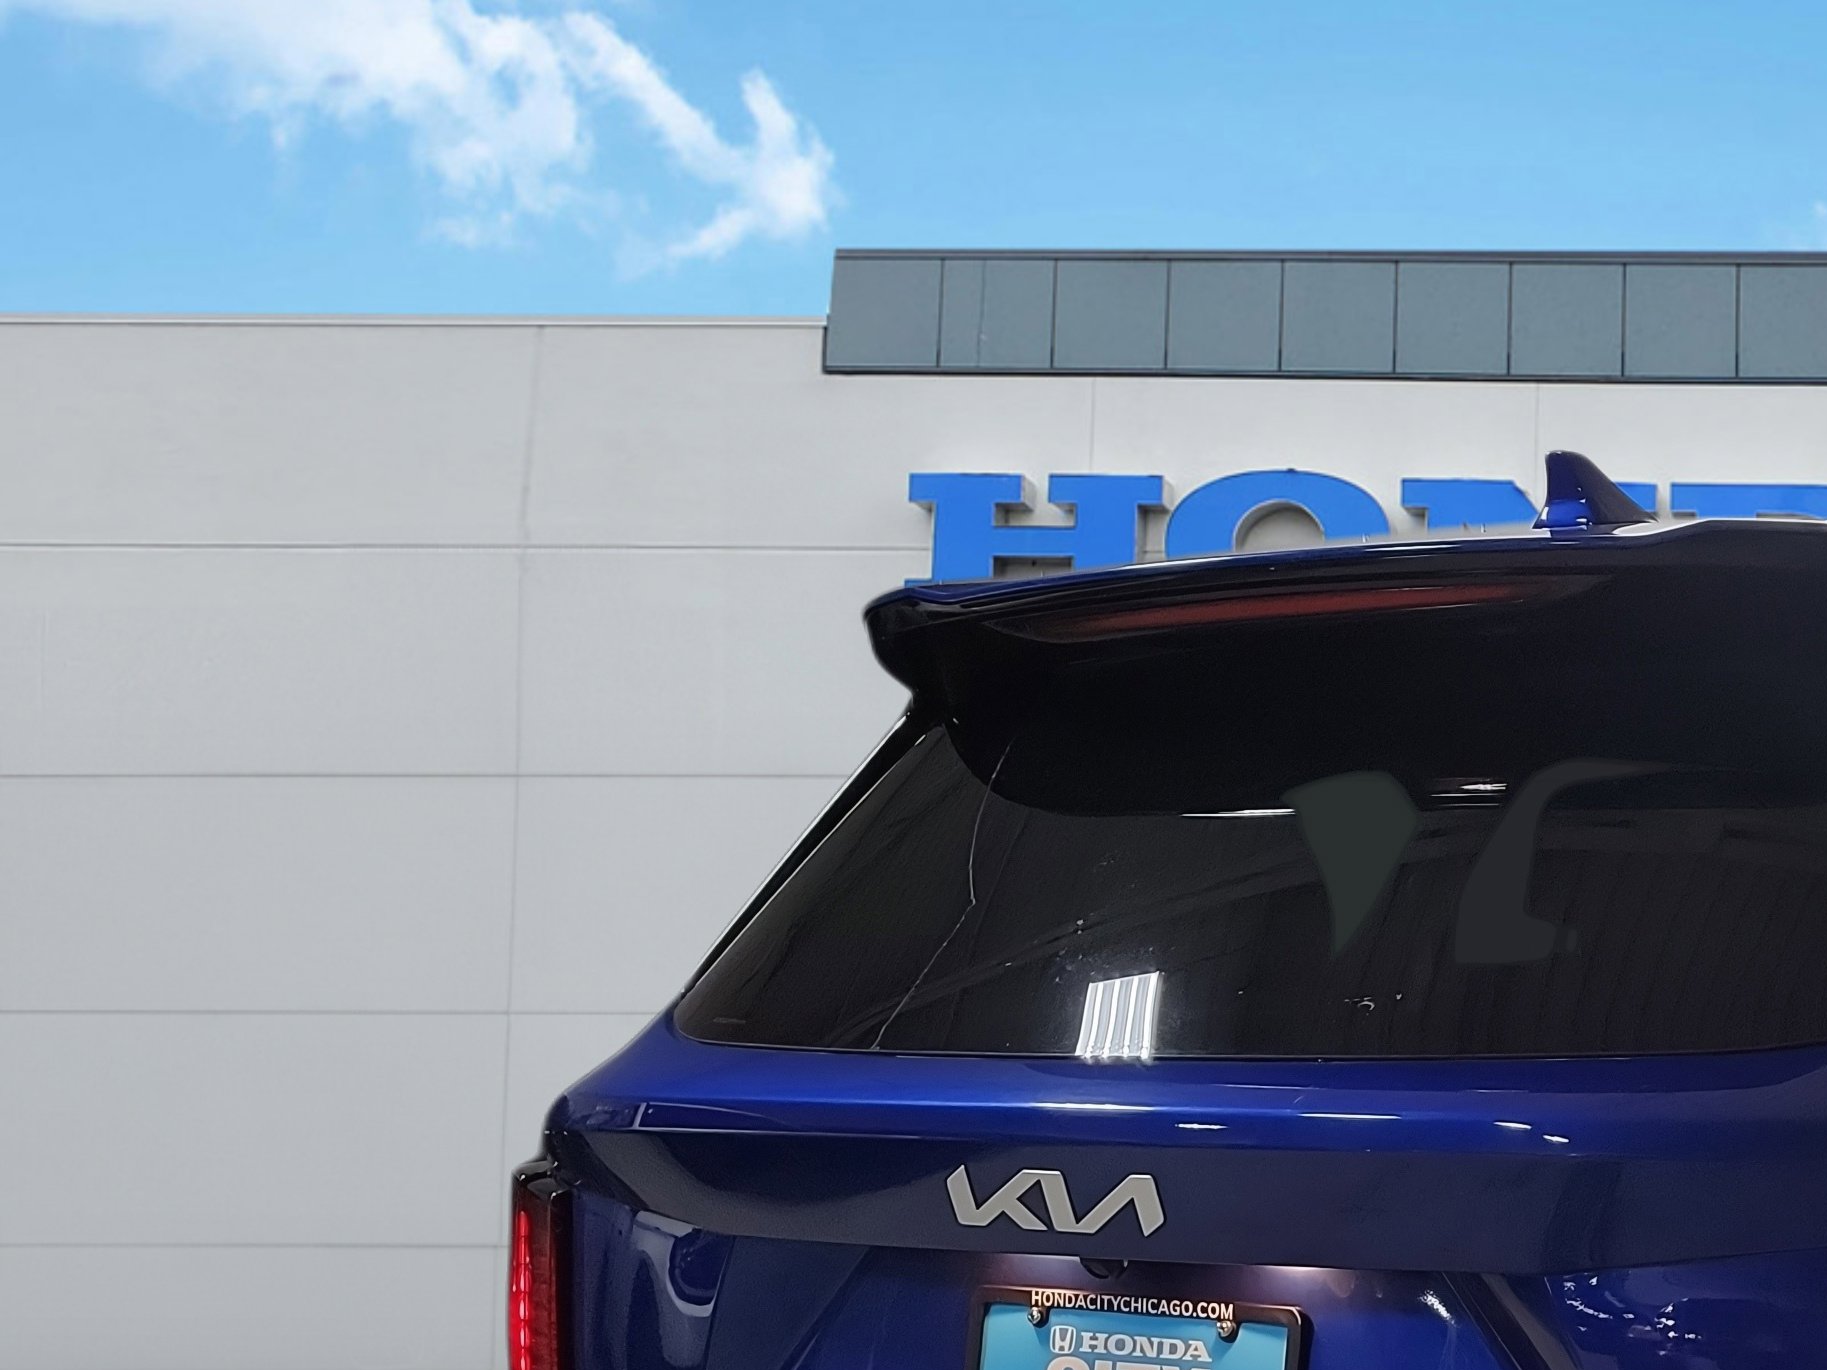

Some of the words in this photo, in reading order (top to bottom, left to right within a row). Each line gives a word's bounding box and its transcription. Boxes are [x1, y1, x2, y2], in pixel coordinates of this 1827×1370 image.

[946, 1164, 1165, 1237] KIA
[1030, 1289, 1235, 1321] HONDACITYCHICAGO.COM
[1080, 1330, 1213, 1363] HONDA
